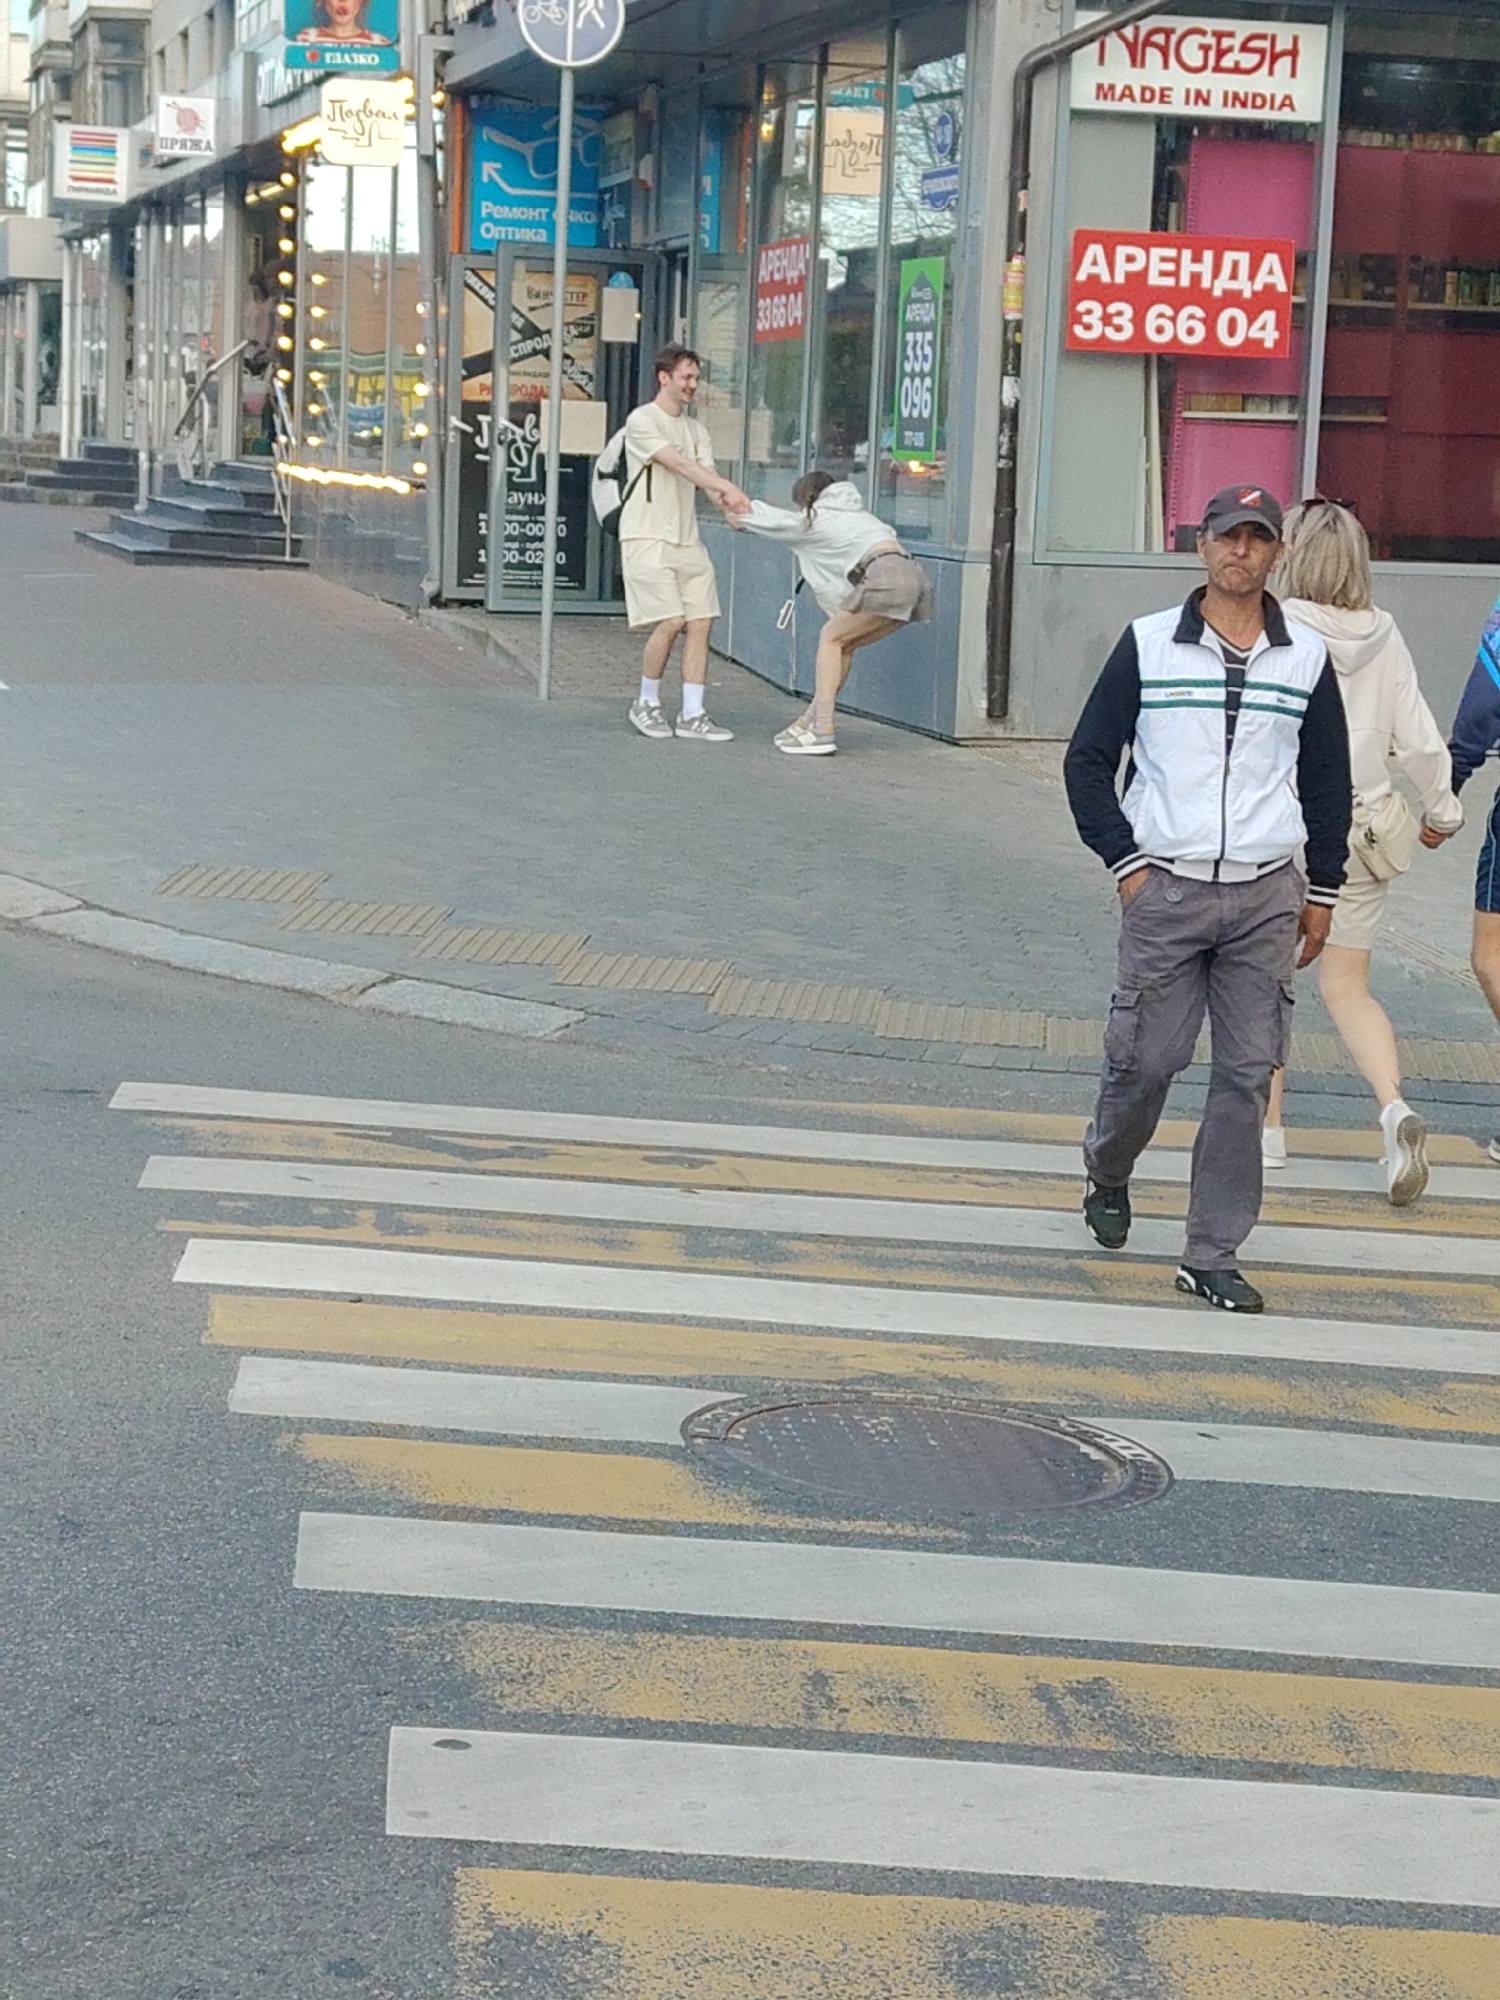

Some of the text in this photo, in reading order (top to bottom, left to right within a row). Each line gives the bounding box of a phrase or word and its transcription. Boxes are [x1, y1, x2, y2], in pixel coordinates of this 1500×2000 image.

[324, 52, 380, 65] ГЛАЗКО
[1097, 24, 1299, 79] NAGESH
[1095, 82, 1297, 112] MADE IN INDIA
[159, 137, 213, 153] ПРЯЖА
[480, 201, 549, 221] Ремонт
[480, 222, 547, 242] Оптика
[758, 243, 806, 286] АРЕНДА
[1075, 243, 1289, 299] АРЕНДА
[757, 298, 772, 332] 33
[772, 294, 787, 330] 66
[788, 291, 803, 328] 04
[905, 302, 936, 324] АРЕНДА
[1073, 299, 1280, 349] 33 66 04
[903, 331, 933, 373] 335
[901, 376, 932, 418] 096
